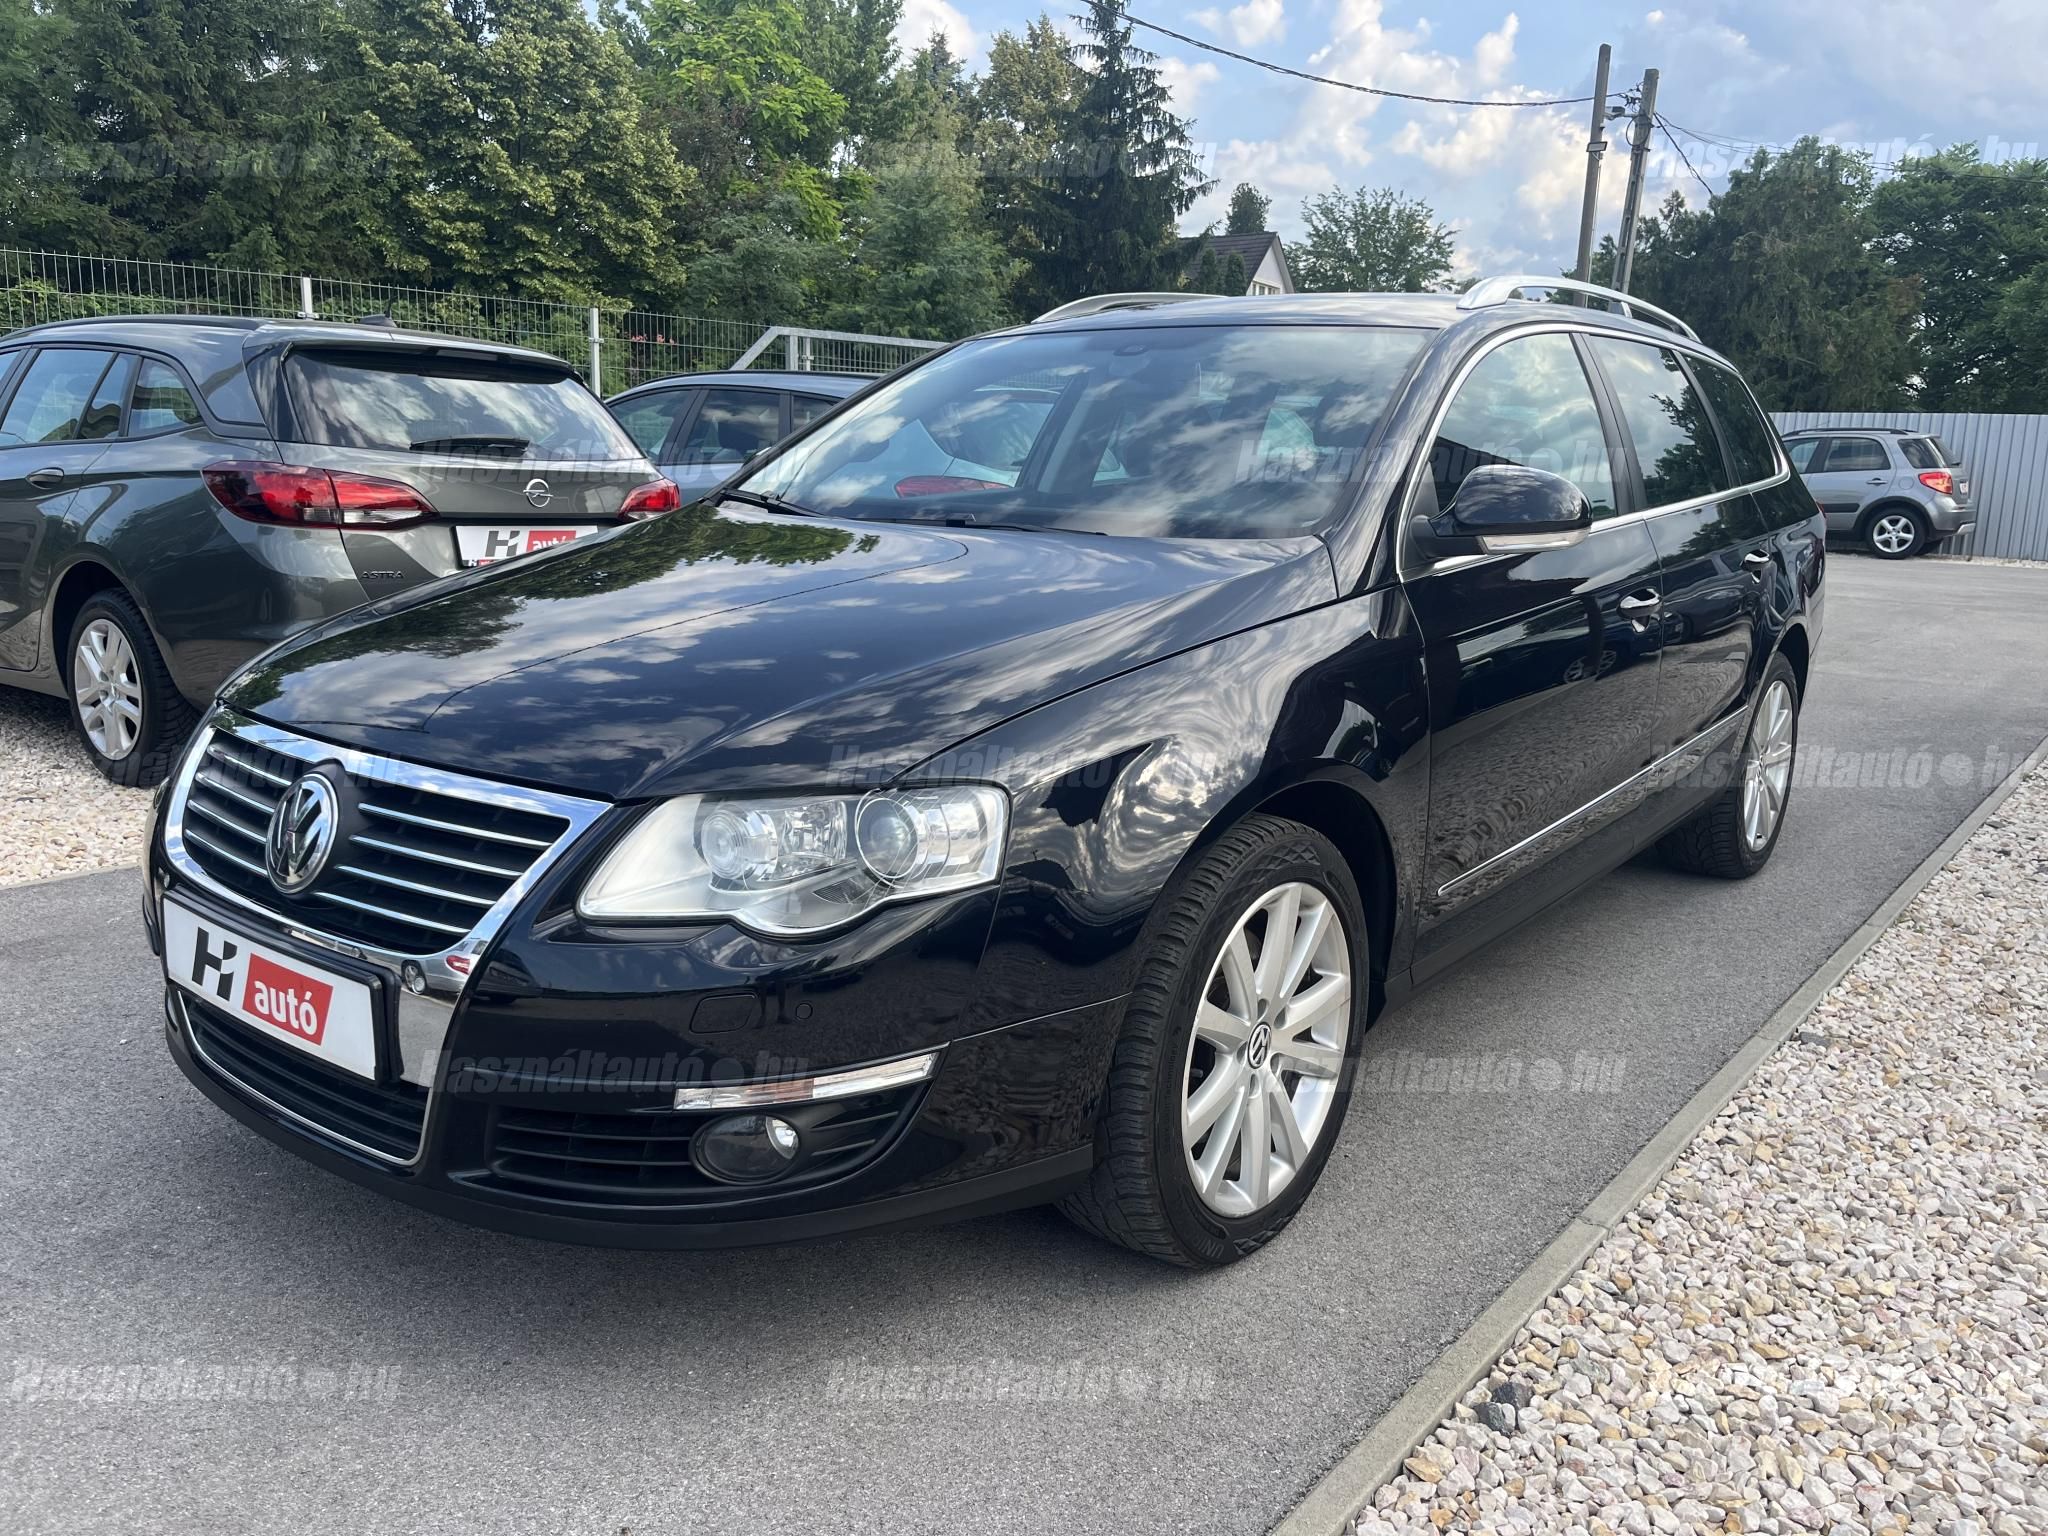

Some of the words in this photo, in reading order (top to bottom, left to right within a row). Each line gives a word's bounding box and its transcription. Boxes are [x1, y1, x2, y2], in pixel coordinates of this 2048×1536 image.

[532, 536, 566, 551] aut
[361, 570, 405, 580] ASTRA
[253, 980, 317, 1036] autó
